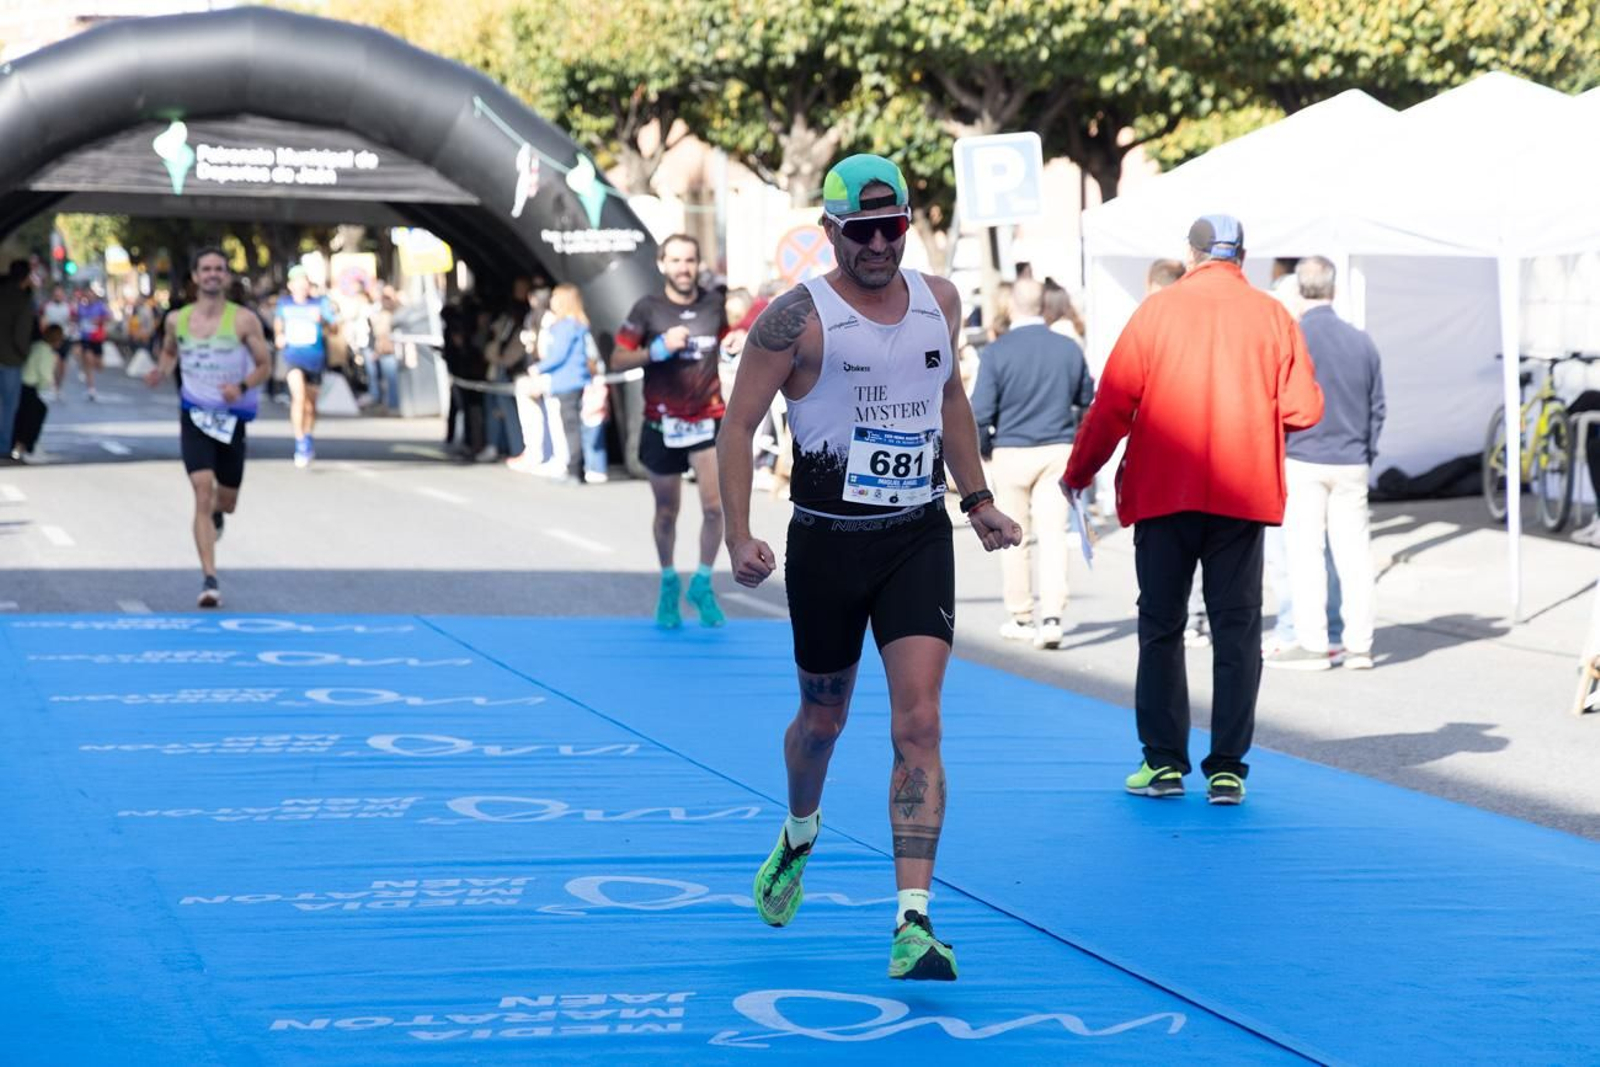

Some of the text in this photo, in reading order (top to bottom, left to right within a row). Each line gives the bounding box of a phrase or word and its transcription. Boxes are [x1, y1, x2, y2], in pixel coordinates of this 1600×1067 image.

[276, 147, 354, 169] Municipal
[355, 150, 379, 169] de
[197, 161, 271, 184] Deportes
[271, 166, 295, 183] de
[972, 145, 1026, 216] P
[854, 385, 888, 402] THE
[854, 399, 930, 423] MYSTERY
[870, 450, 924, 478] 681
[831, 507, 926, 532] NIKE PRO
[407, 1022, 684, 1041] MEDIA
